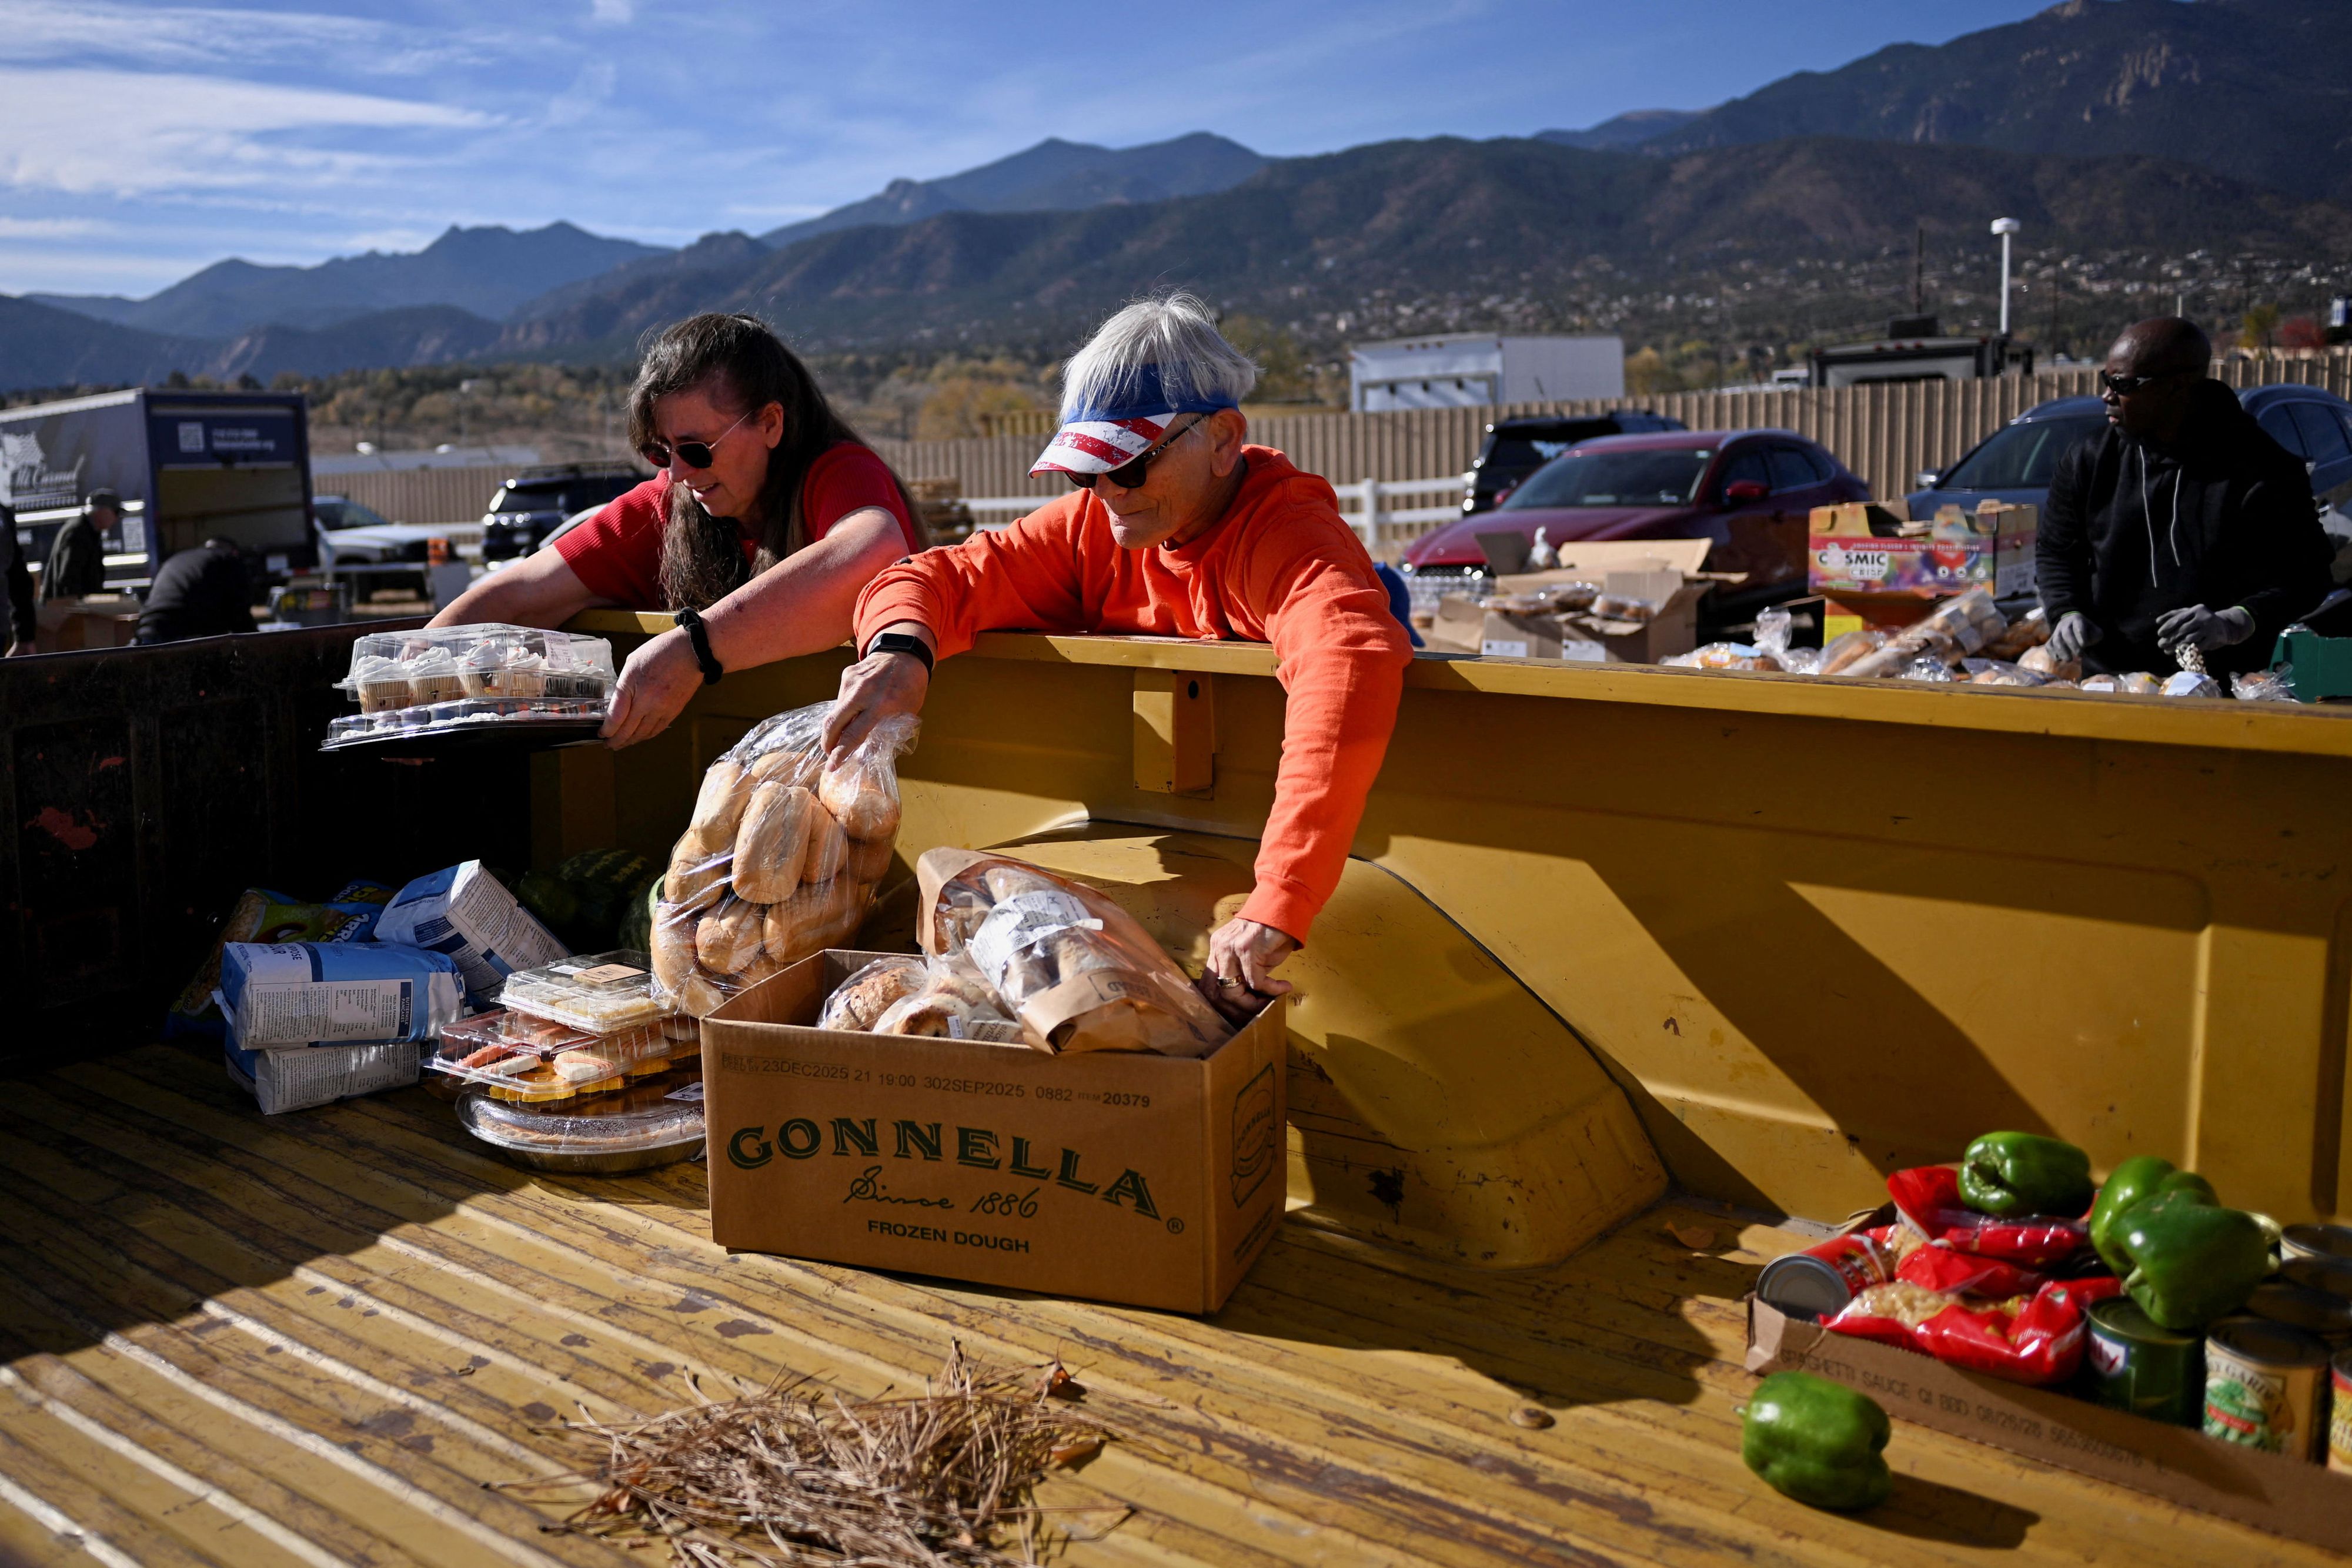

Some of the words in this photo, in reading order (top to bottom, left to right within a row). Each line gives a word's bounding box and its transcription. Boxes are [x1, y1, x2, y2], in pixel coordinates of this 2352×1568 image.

[763, 1059, 848, 1079] 23DEC2025
[854, 1069, 870, 1082] 21
[878, 1074, 916, 1087] 19:00
[924, 1076, 1025, 1098] 302SEP2025
[1035, 1086, 1073, 1102] 0882
[1102, 1092, 1151, 1108] 20379
[726, 1117, 1162, 1222] GONNELLA
[843, 1165, 955, 1209] Since
[970, 1188, 1040, 1219] 1886
[867, 1219, 947, 1244] FROZEN
[954, 1229, 1030, 1254] DOUGH
[1779, 1348, 1858, 1381] SPAGHETTI
[1862, 1372, 1914, 1399] SAUCE
